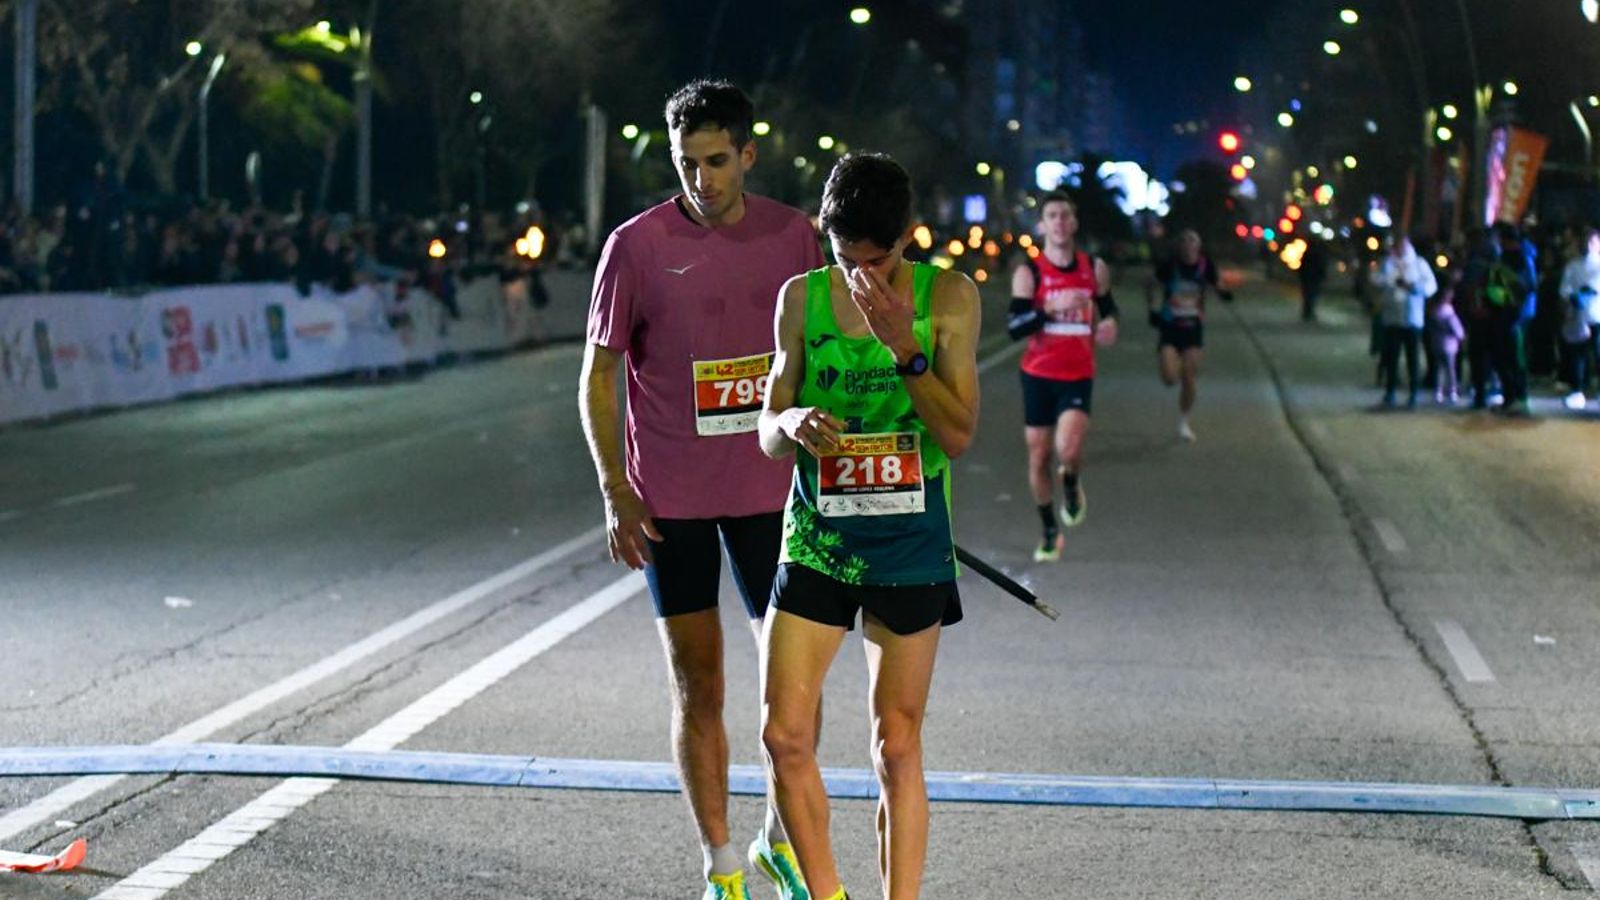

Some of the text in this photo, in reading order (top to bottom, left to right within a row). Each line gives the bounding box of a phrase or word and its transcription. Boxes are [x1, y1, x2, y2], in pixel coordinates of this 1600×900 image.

[844, 365, 897, 381] Fundac
[713, 376, 769, 408] 799
[844, 380, 898, 396] Unicaja
[835, 455, 903, 486] 218
